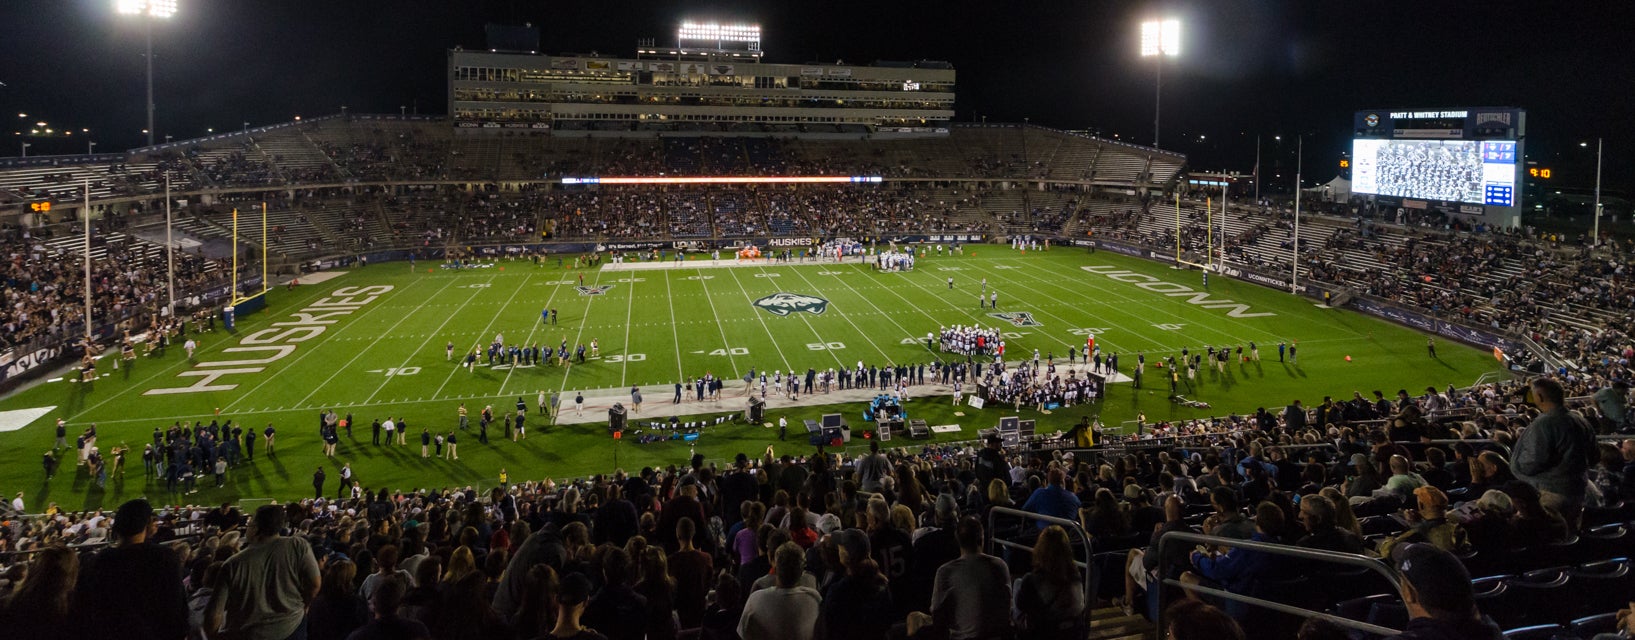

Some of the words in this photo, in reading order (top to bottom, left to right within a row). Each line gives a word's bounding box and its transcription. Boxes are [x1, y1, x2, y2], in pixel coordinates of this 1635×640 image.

[1413, 111, 1439, 119] WHITNEY
[1530, 168, 1551, 178] 9:10
[769, 238, 812, 246] HUSKIES
[1080, 265, 1278, 318] UCONN
[141, 285, 395, 396] HUSKIES
[708, 347, 749, 356] 40
[806, 342, 846, 351] 50
[604, 353, 646, 363] 30
[384, 366, 422, 377] 10
